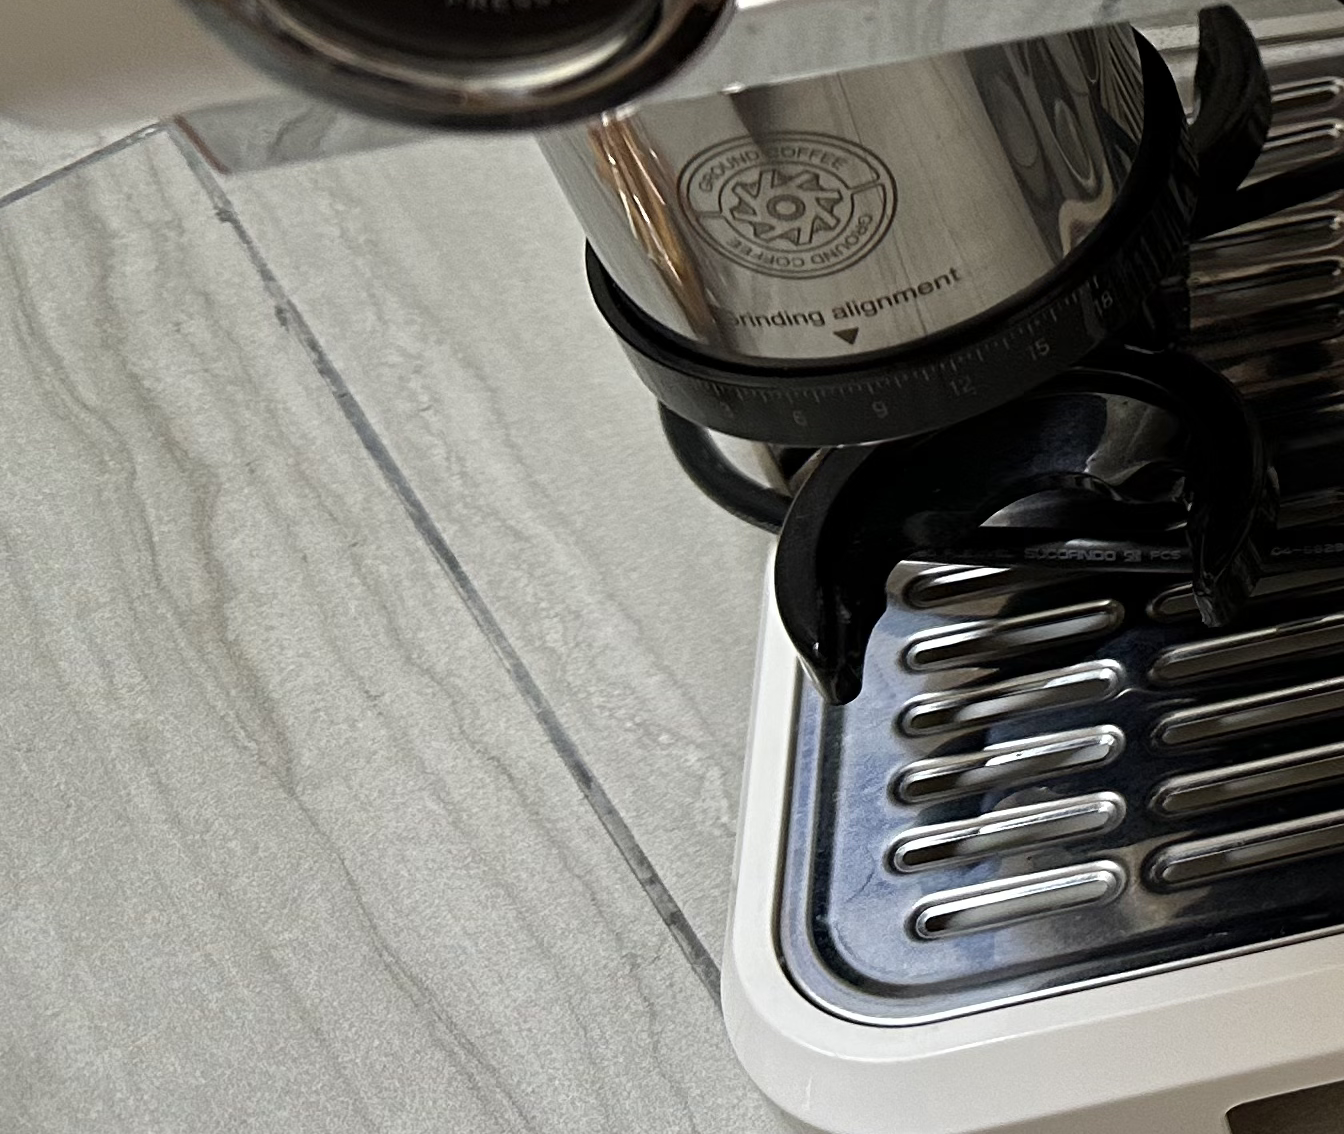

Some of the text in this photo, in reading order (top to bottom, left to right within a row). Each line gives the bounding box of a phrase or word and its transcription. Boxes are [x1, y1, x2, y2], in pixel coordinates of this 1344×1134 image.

[699, 146, 850, 193] GROUND COFFEE
[725, 213, 873, 269] GROUND COFFEE
[831, 266, 962, 321] alignment
[792, 409, 808, 427] 6
[872, 400, 889, 419] 9
[948, 374, 977, 398] 12
[1027, 338, 1051, 362] 15
